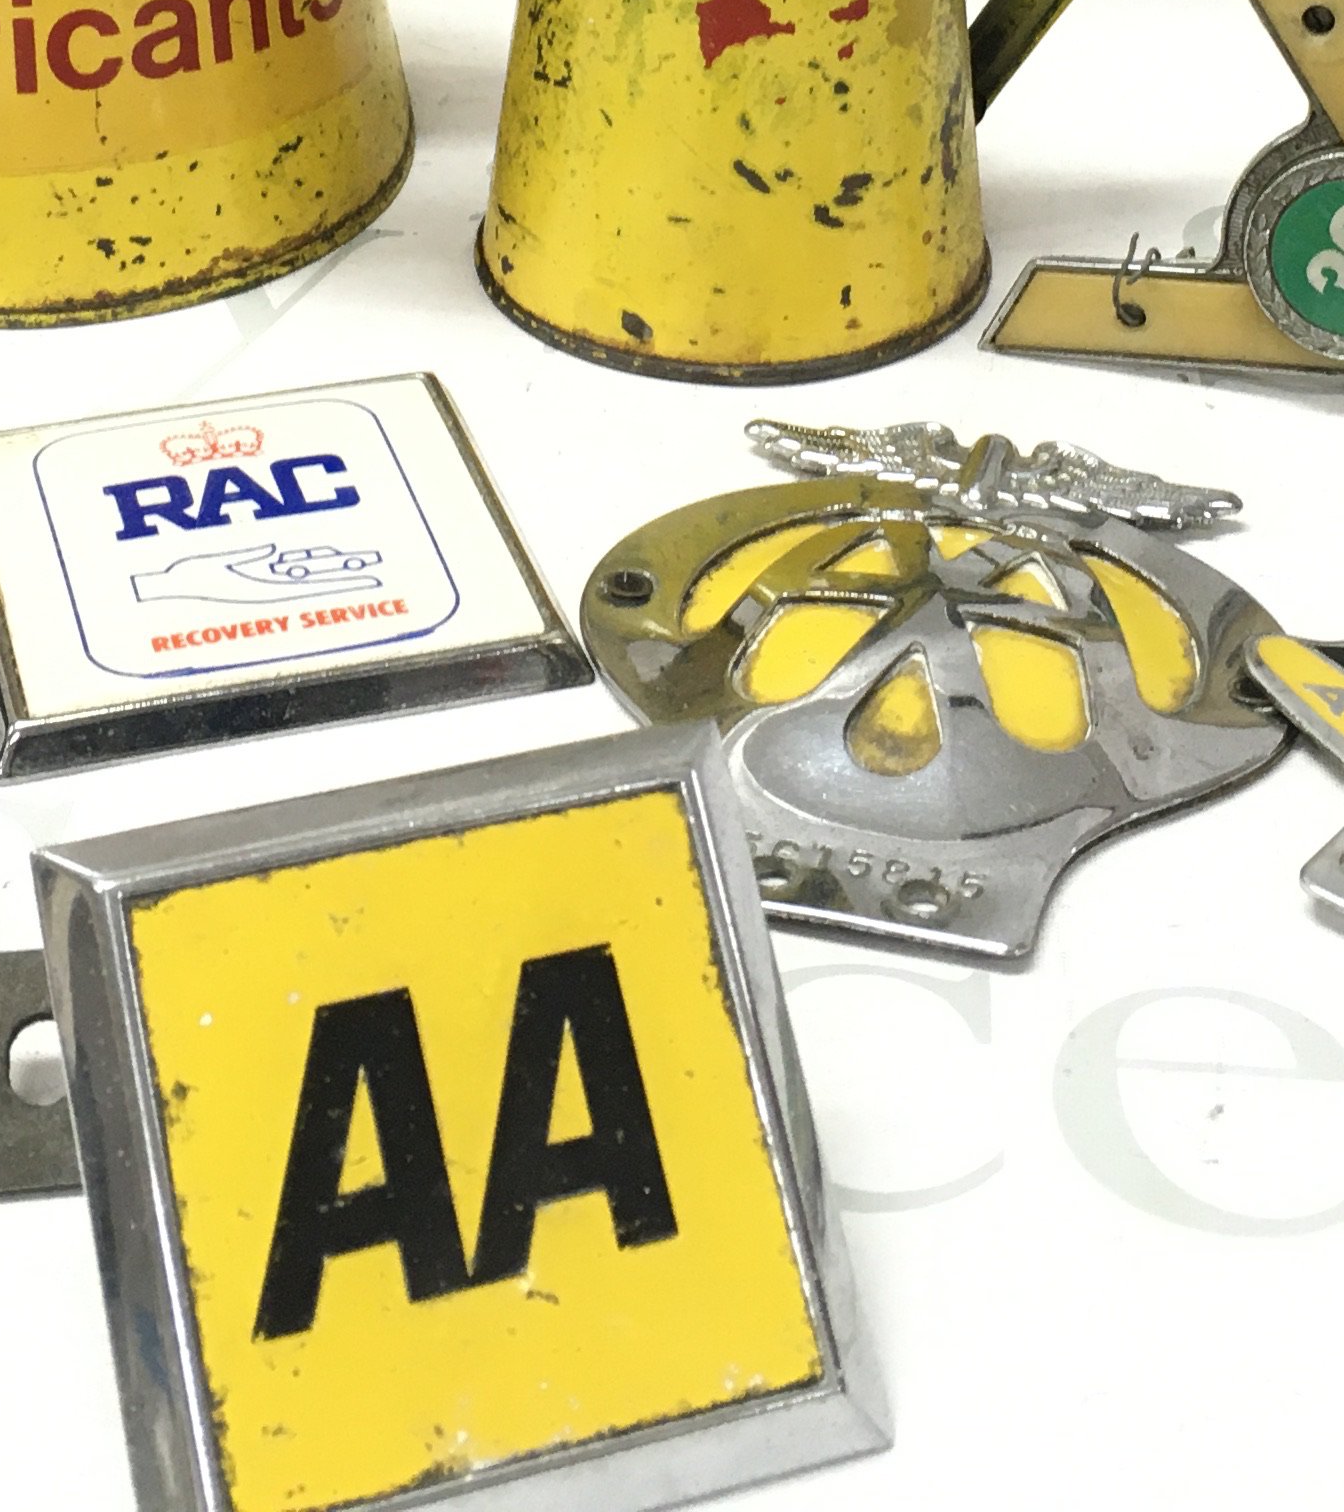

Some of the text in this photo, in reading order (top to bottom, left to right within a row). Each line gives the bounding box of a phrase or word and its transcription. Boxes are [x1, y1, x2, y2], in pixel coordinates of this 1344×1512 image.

[102, 453, 361, 541] RAC
[151, 599, 409, 653] RECOVERY SERVICE
[252, 941, 679, 1344] AA
